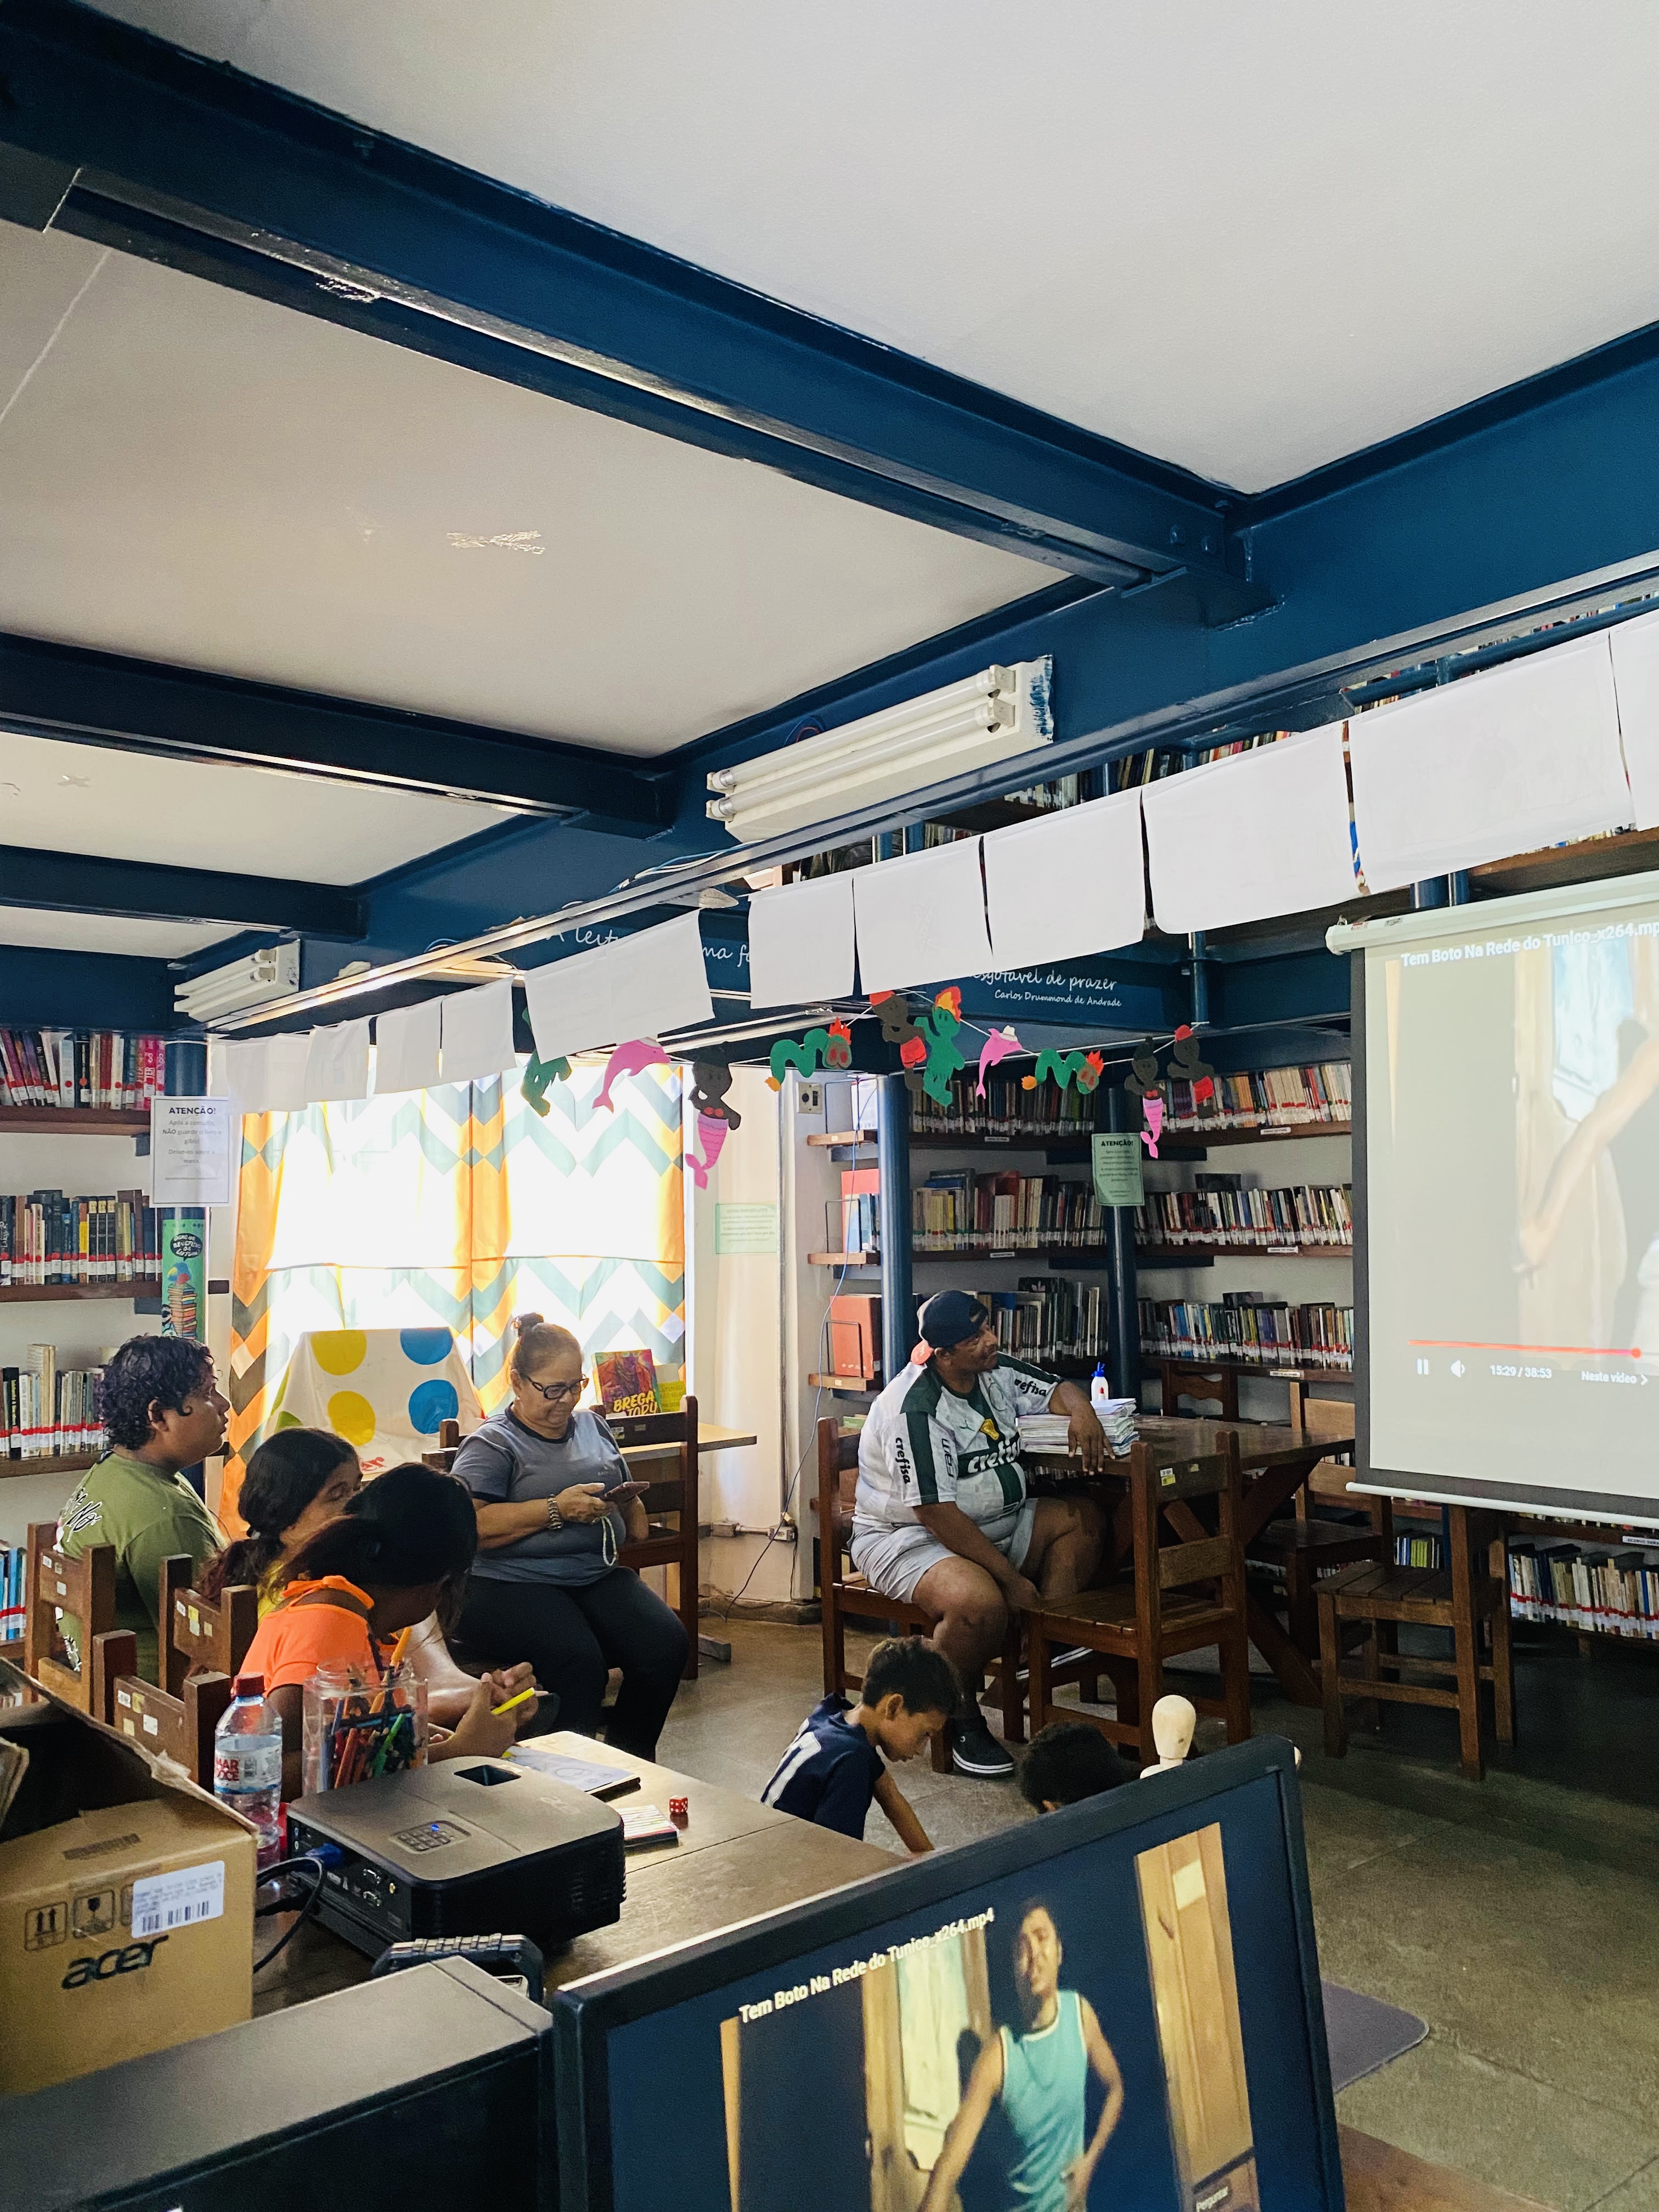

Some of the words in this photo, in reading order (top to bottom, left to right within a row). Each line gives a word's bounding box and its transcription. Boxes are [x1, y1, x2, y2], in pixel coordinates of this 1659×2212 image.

[702, 946, 732, 960] ma
[1401, 952, 1429, 967] Tem
[1431, 947, 1462, 963] Boto
[1464, 944, 1483, 959] Na
[1486, 938, 1520, 956] Rede
[1522, 935, 1541, 951] do
[1543, 922, 1659, 948] Tunico_x264.mp
[1046, 969, 1066, 986] de
[1069, 977, 1118, 991] prazer
[995, 989, 1023, 1000] Carlos
[1024, 991, 1073, 1003] Drummond
[1074, 995, 1085, 1004] de
[1086, 996, 1121, 1007] Andrade
[169, 1105, 216, 1116] ATENÇÃO!
[1489, 1365, 1516, 1377] 15:29
[1525, 1367, 1552, 1379] 38:53
[1581, 1371, 1609, 1382] Neste
[1014, 1378, 1047, 1397] refisa
[613, 1390, 654, 1413] BREGA
[627, 1401, 658, 1416] TORY
[895, 1437, 911, 1485] crefisa
[967, 1440, 1020, 1474] crefis
[61, 1934, 169, 1990] acer
[738, 1997, 773, 2023] Tem
[774, 1985, 808, 2010] Boto
[810, 1974, 830, 1996] Na
[832, 1960, 867, 1987] Rede
[866, 1951, 887, 1970] do
[887, 1907, 995, 1963] Tunico_x264.mp4
